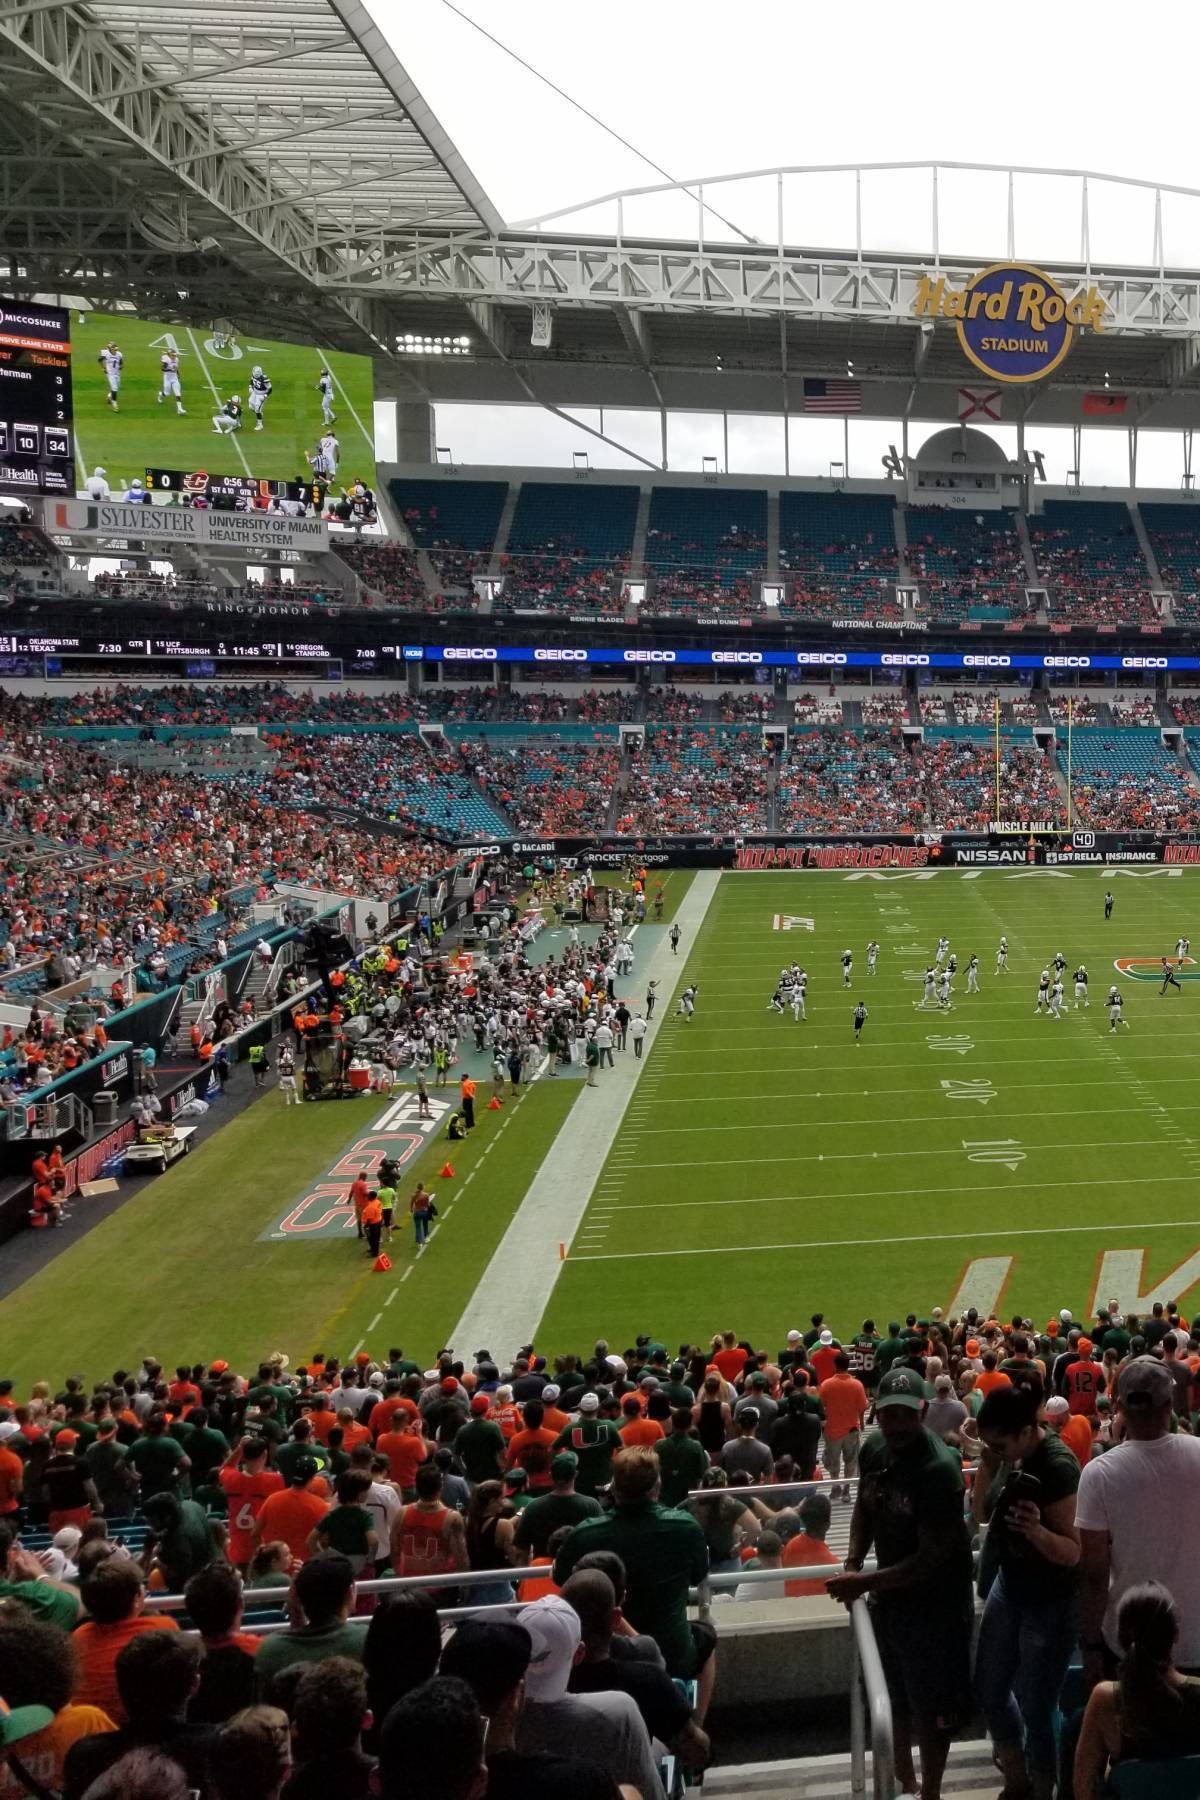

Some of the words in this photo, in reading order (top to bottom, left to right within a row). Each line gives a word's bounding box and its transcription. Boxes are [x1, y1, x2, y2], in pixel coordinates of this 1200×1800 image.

[917, 275, 1013, 321] Hard
[1017, 283, 1106, 333] Rock
[5, 314, 61, 328] MICCOSUKEE
[981, 338, 1048, 353] STADIUM
[56, 376, 63, 385] 3
[57, 393, 63, 403] 3
[57, 411, 64, 419] 2
[20, 437, 34, 449] 10
[49, 440, 66, 452] 34
[161, 475, 170, 487] 0
[224, 477, 242, 487] 0:56
[298, 488, 306, 498] 7
[101, 508, 194, 531] SYLVESTER
[209, 515, 270, 531] UNIVERSITY
[272, 521, 286, 532] OF
[288, 522, 322, 534] MIAMI
[209, 529, 250, 542] HEALTH
[252, 533, 293, 545] SYSTEM
[207, 603, 244, 613] RING
[258, 606, 309, 616] HONOR
[832, 620, 874, 629] NATIONAL
[875, 621, 928, 630] CHAMPIONS
[99, 644, 122, 653] 7:30
[167, 647, 210, 655] PITTSBURGH
[233, 646, 259, 656] 11:45
[443, 648, 497, 659] GEICO
[534, 650, 588, 660] GEICO
[624, 650, 676, 661] GEICO
[712, 651, 763, 663] GEICO
[797, 652, 847, 664] GEICO
[881, 653, 930, 665] GEICO
[963, 655, 1010, 666] GEICO
[1043, 656, 1090, 667] GEICO
[1122, 657, 1168, 667] GEICO
[989, 822, 1027, 832] MUSCLE
[1030, 822, 1054, 832] MILK
[522, 841, 555, 851] BACARDÍ
[1076, 835, 1092, 846] 40
[737, 847, 805, 868] MIAMI
[808, 846, 929, 868] HURRICANES
[957, 850, 1025, 861] NISSAN
[961, 1139, 1028, 1164] 10
[855, 1353, 875, 1371] 26
[1076, 1371, 1093, 1392] 12
[236, 1503, 254, 1530] 6
